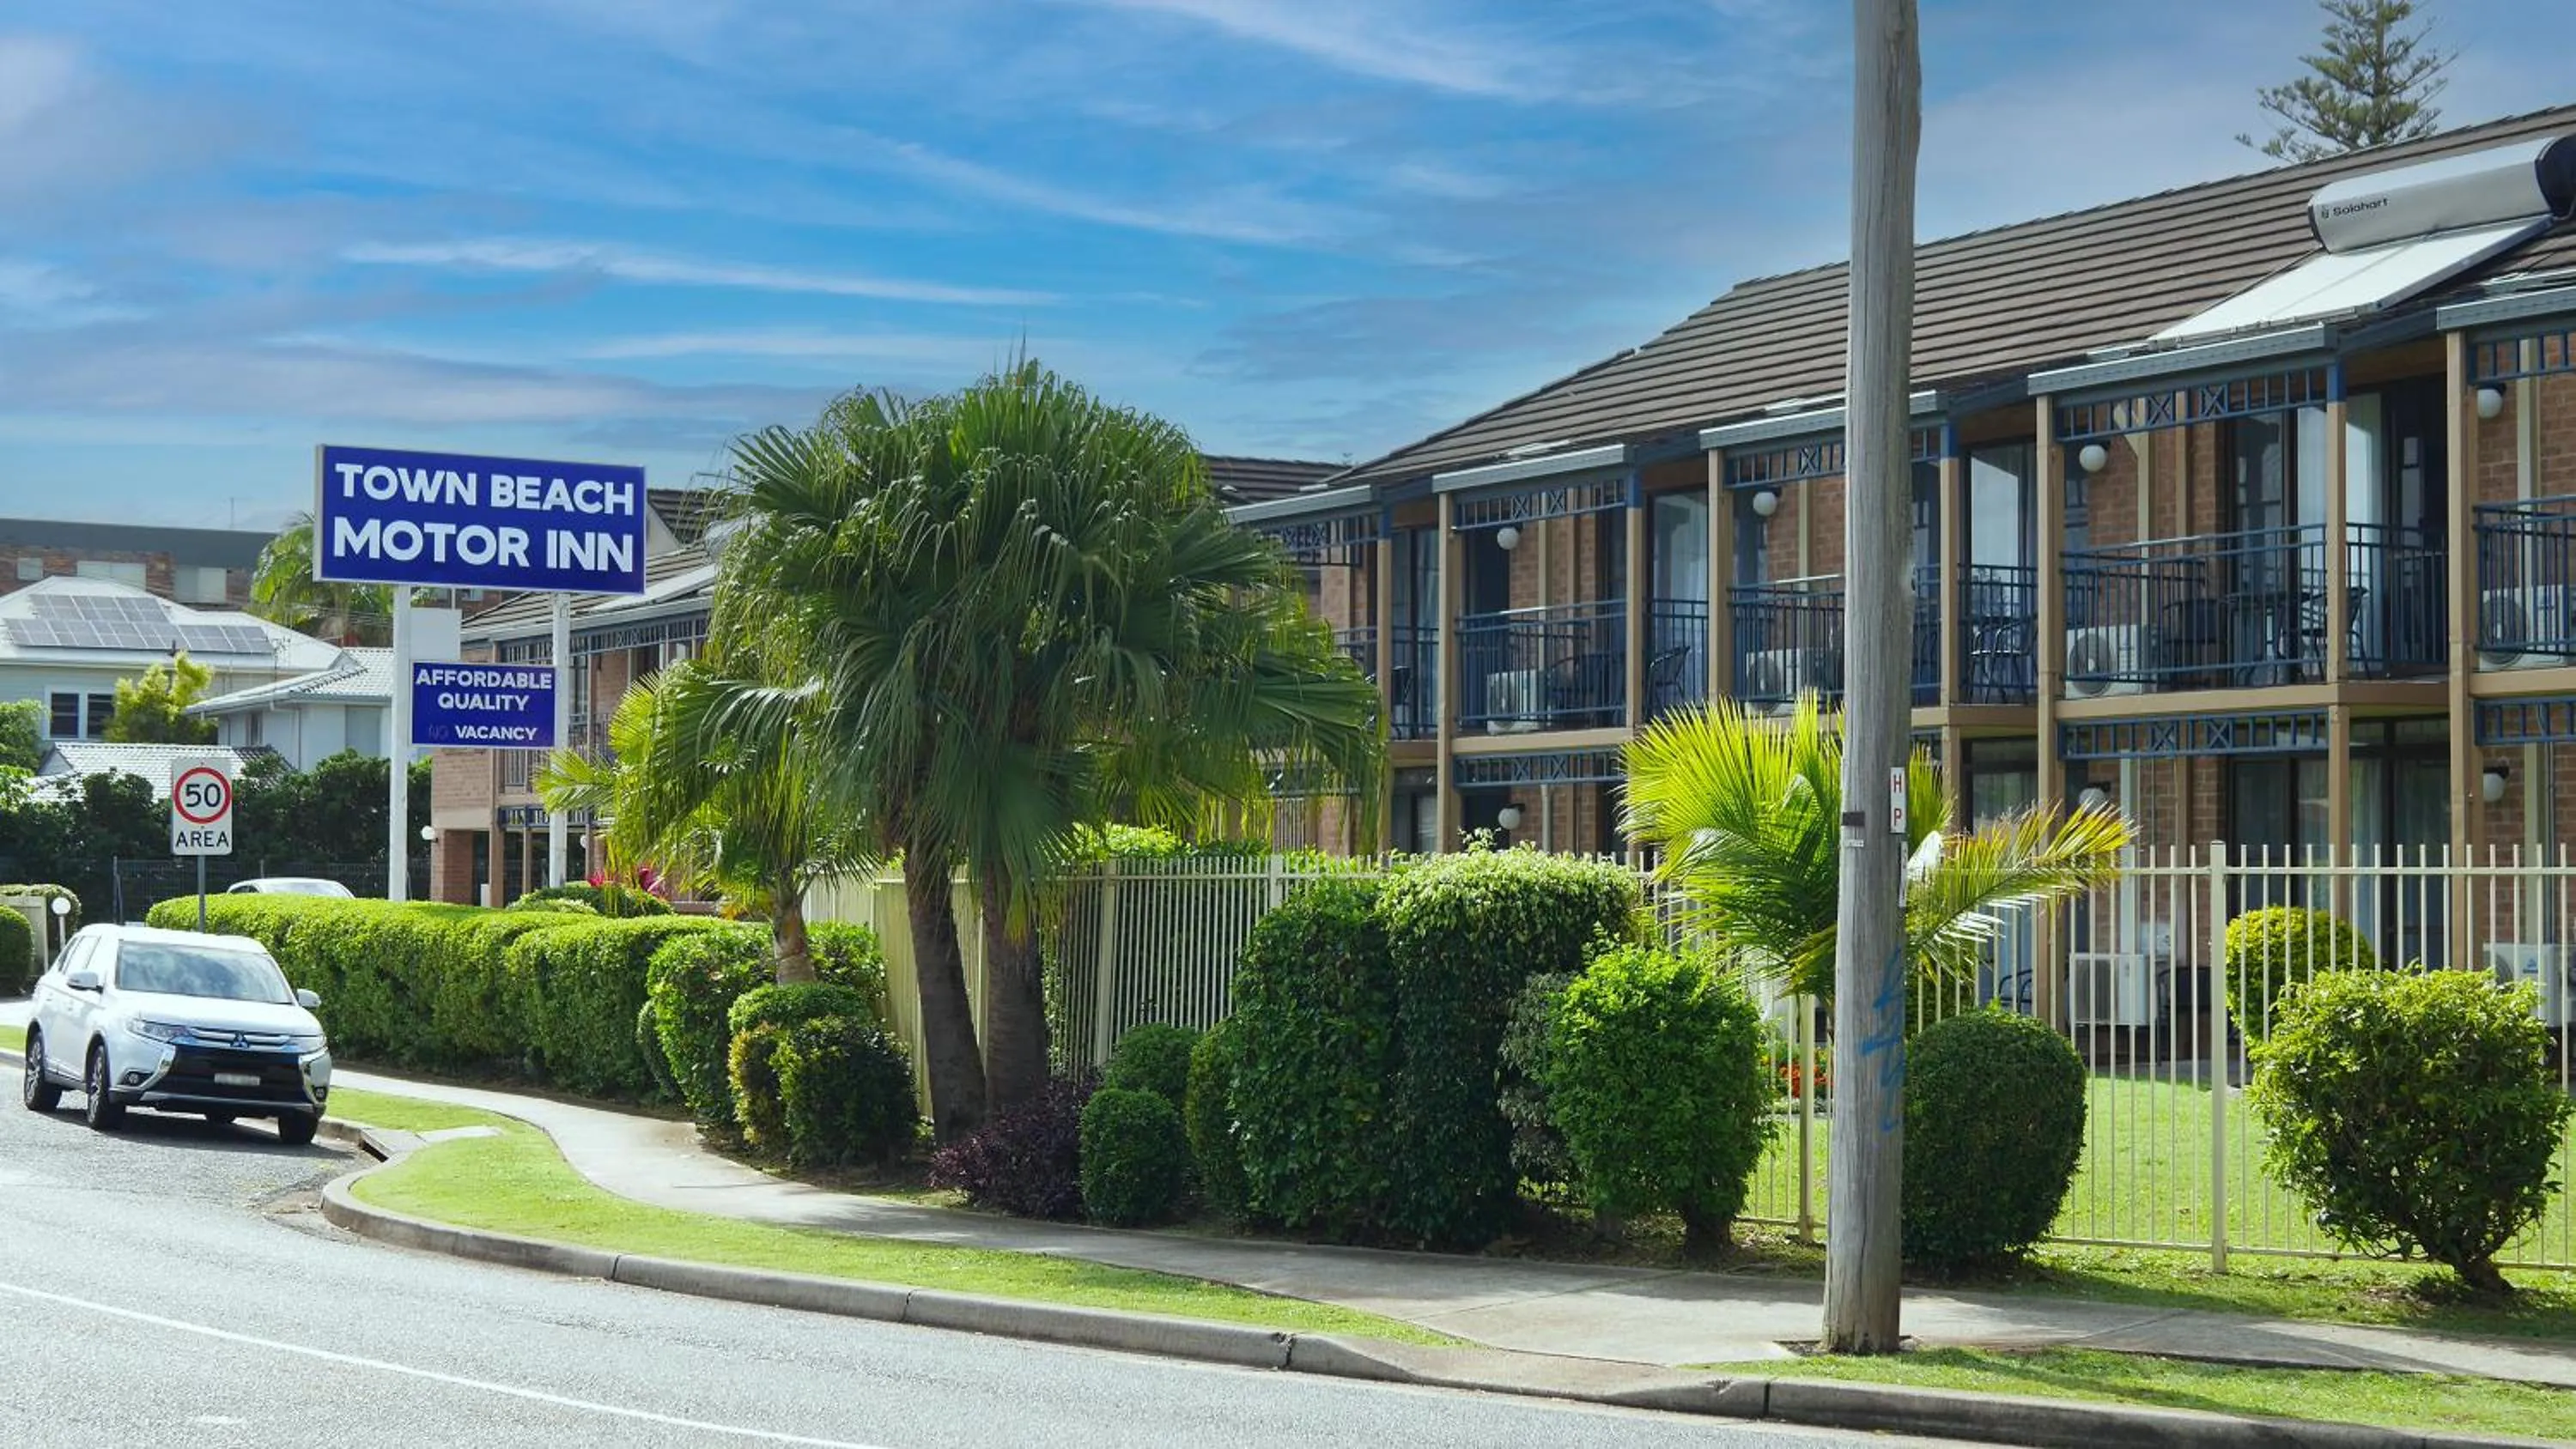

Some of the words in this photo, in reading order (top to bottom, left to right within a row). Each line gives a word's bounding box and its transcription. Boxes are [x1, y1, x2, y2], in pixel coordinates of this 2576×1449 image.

[335, 464, 477, 506] TOWN
[490, 474, 634, 515] BEACH
[334, 518, 530, 567] MOTOR
[546, 530, 633, 573] INN
[416, 669, 552, 689] AFFORDABLE
[437, 692, 529, 711] QUALITY
[455, 725, 538, 741] VACANCY
[185, 783, 221, 808] 50
[175, 831, 229, 847] AREA
